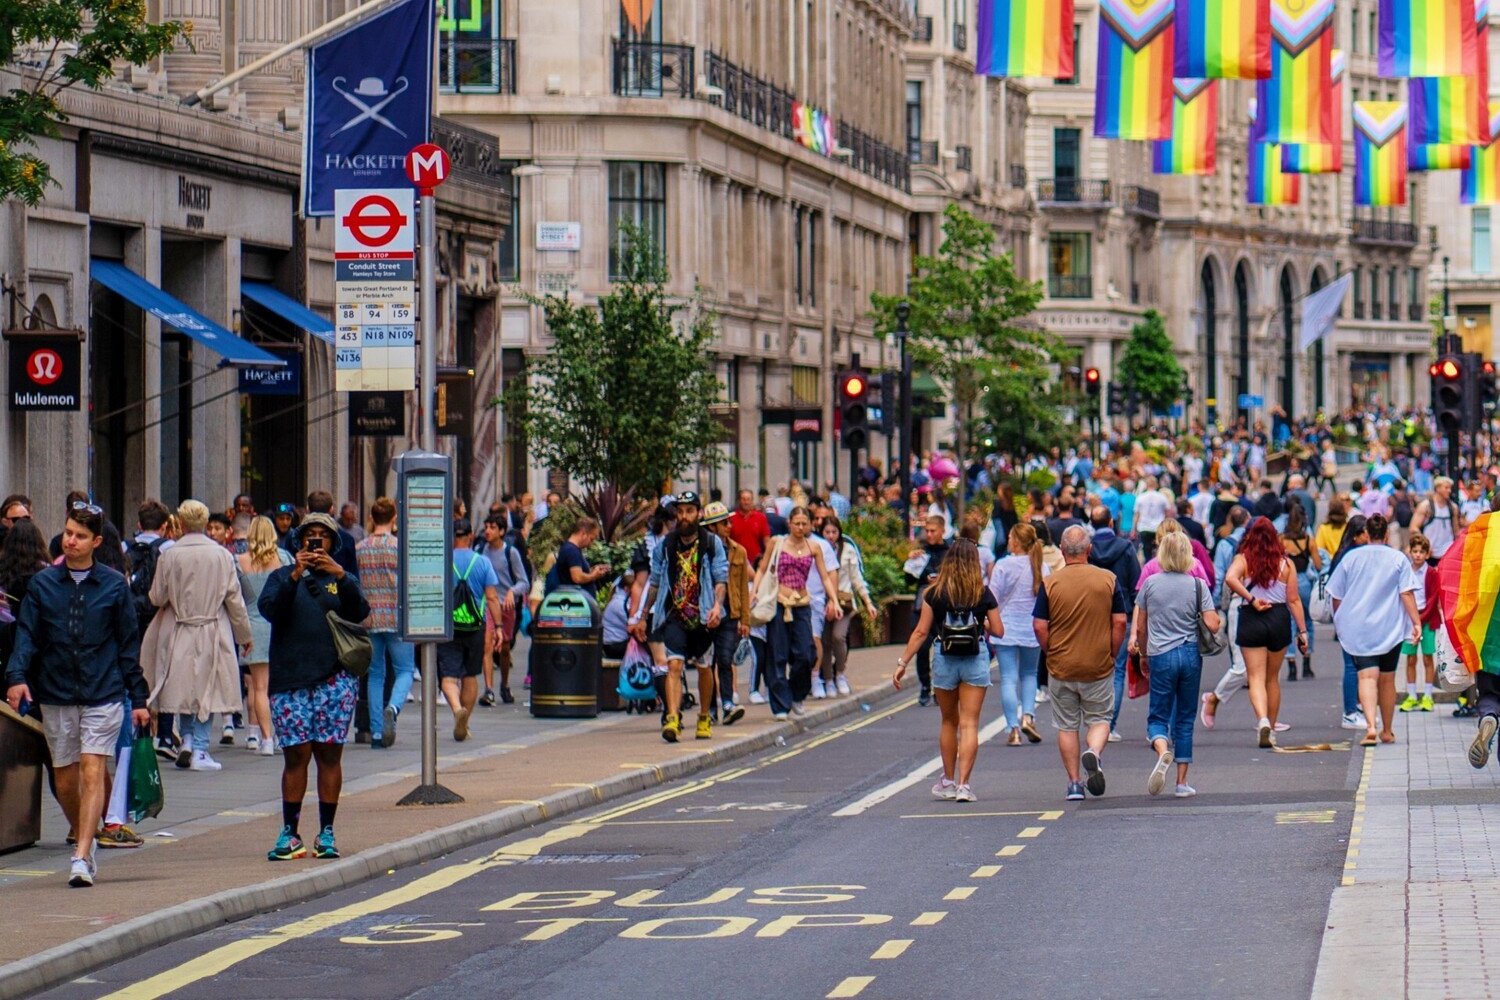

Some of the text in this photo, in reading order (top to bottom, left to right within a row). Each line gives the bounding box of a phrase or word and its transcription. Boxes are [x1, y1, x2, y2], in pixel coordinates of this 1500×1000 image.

[325, 153, 407, 169] HACKETT
[411, 150, 444, 182] M
[178, 174, 212, 212] HACKETT
[343, 310, 354, 318] 88
[369, 310, 381, 318] 94
[393, 309, 409, 318] 159
[341, 332, 357, 341] 453
[365, 331, 384, 340] N18
[388, 330, 413, 339] N109
[336, 353, 361, 362] N136
[245, 369, 293, 381] HACKETT
[15, 392, 74, 406] lululemon
[629, 664, 651, 685] JD
[478, 884, 868, 912] BUS
[338, 913, 894, 945] STOP
